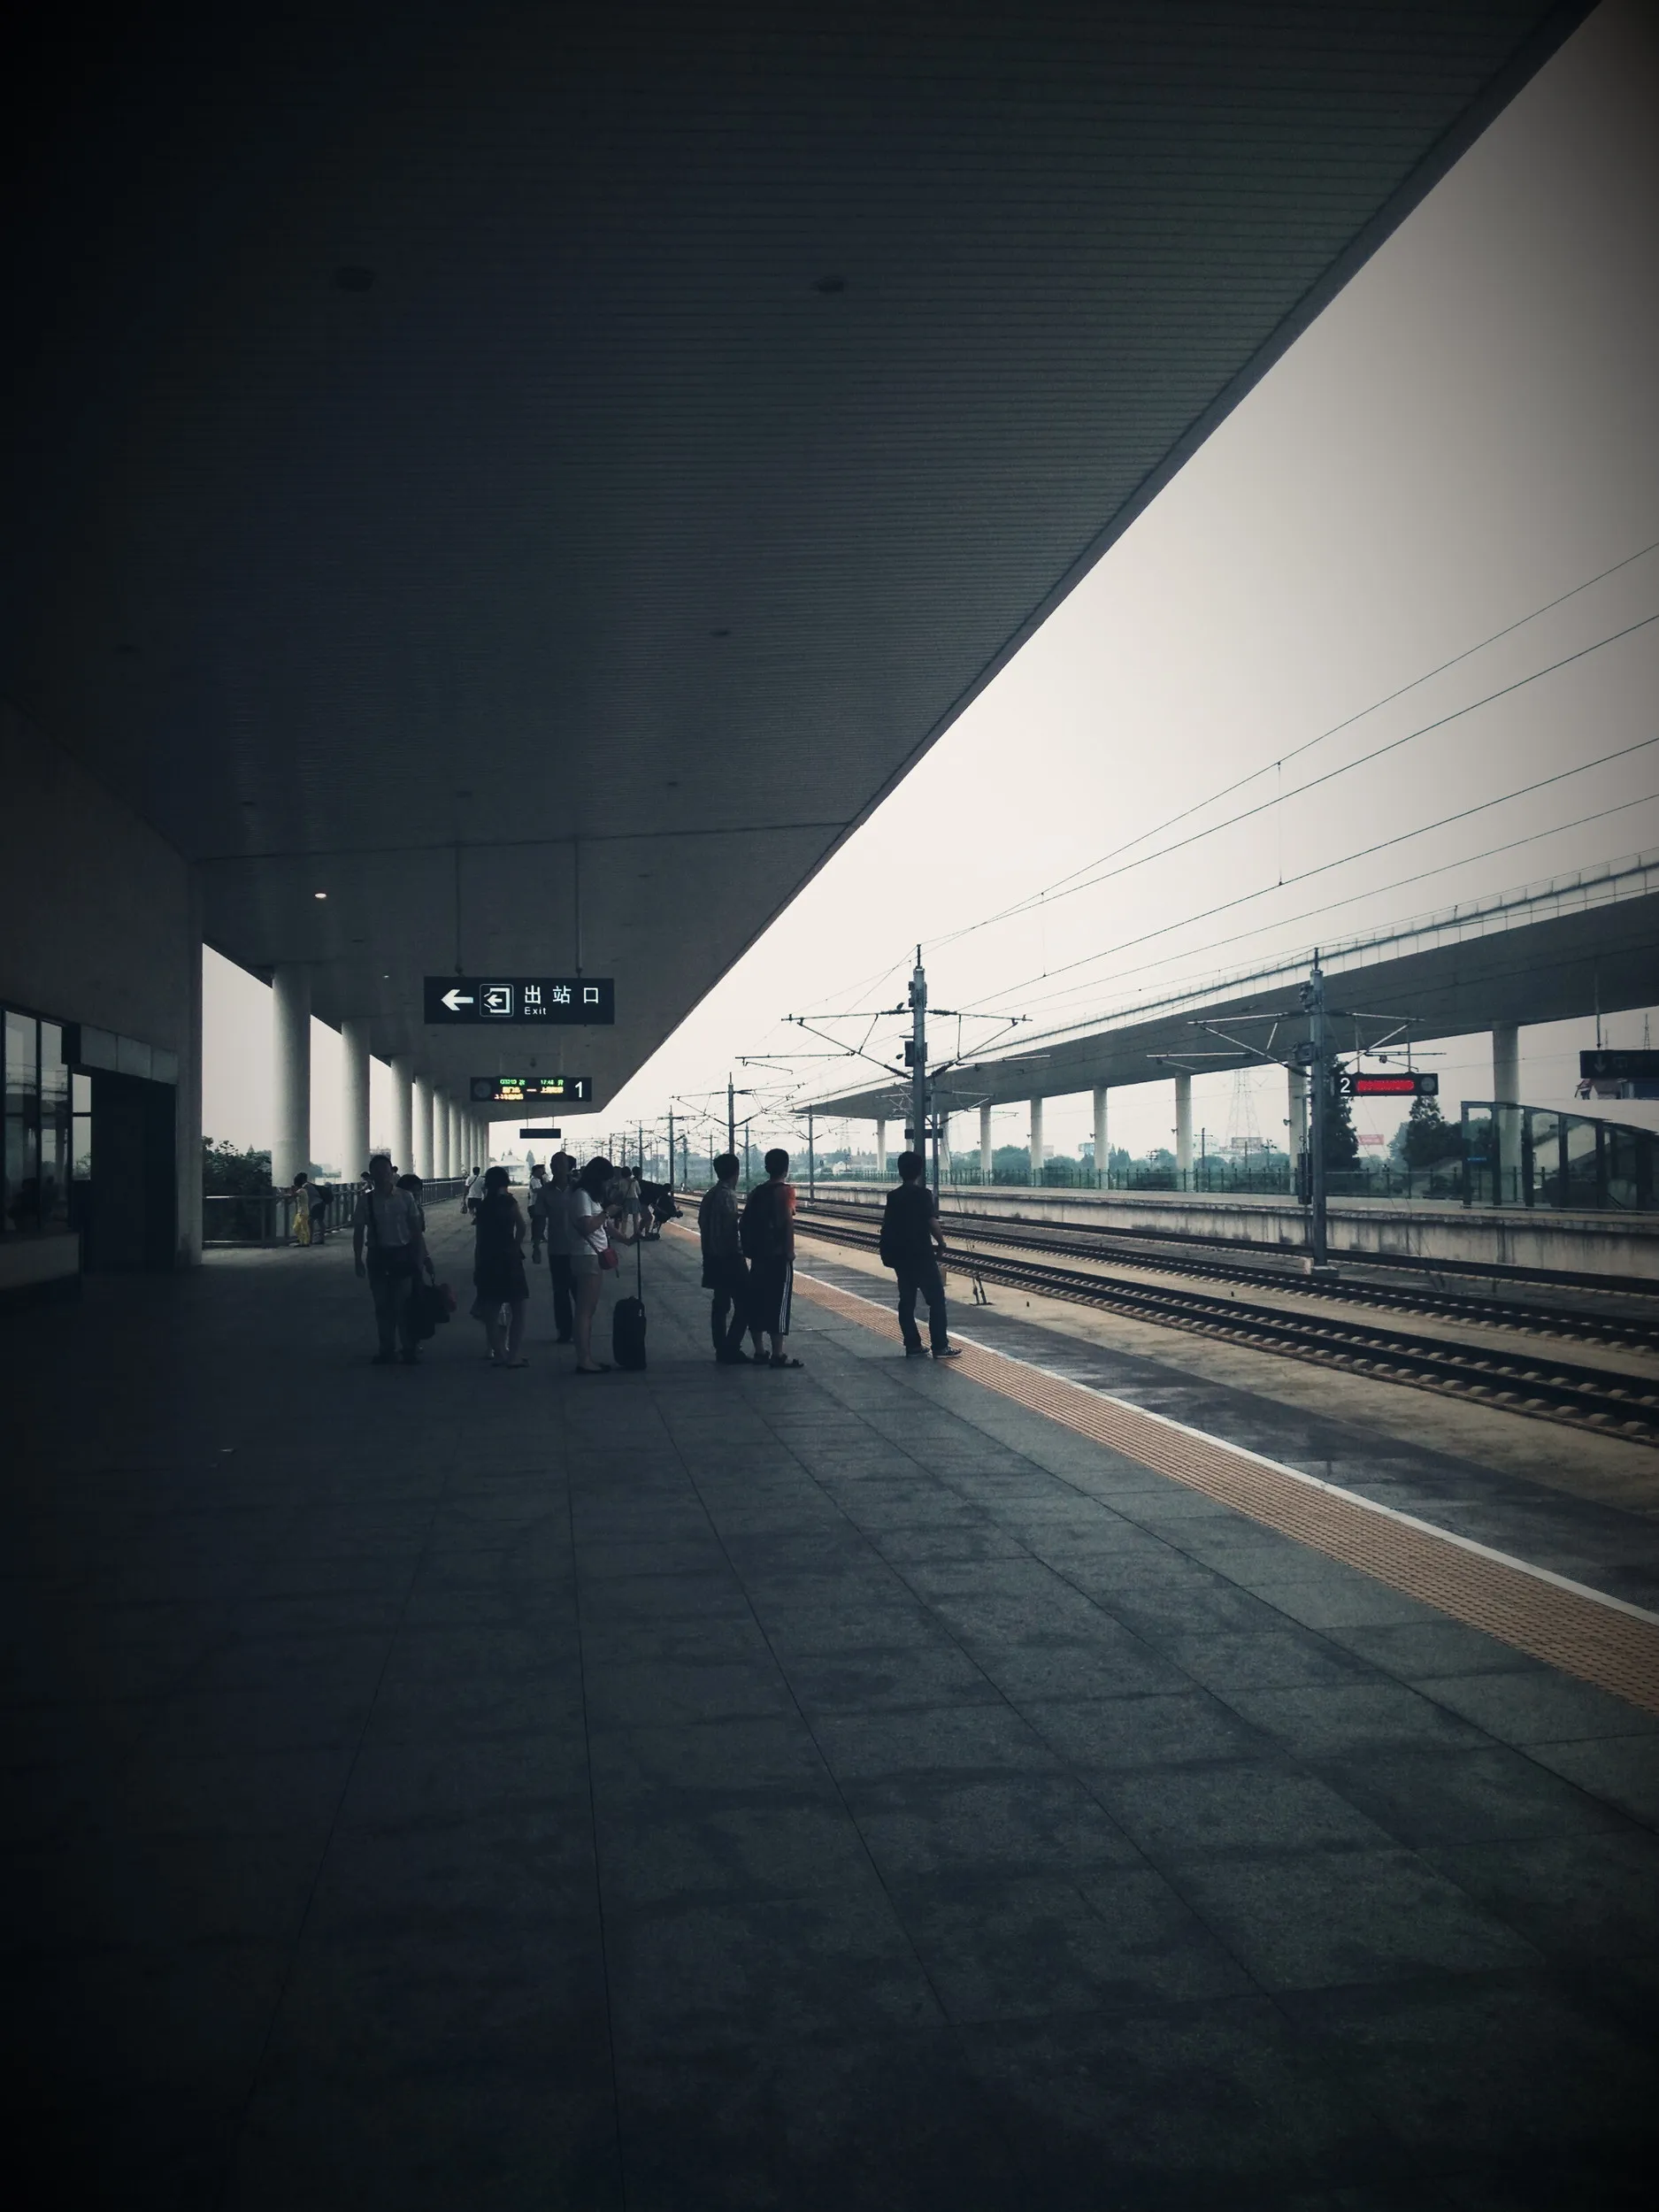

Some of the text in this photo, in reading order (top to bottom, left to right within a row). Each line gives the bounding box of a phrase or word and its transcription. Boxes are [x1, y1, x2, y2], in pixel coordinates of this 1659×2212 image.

[525, 985, 599, 1004] 出站口
[574, 1081, 583, 1098] 1
[1340, 1077, 1351, 1094] 2
